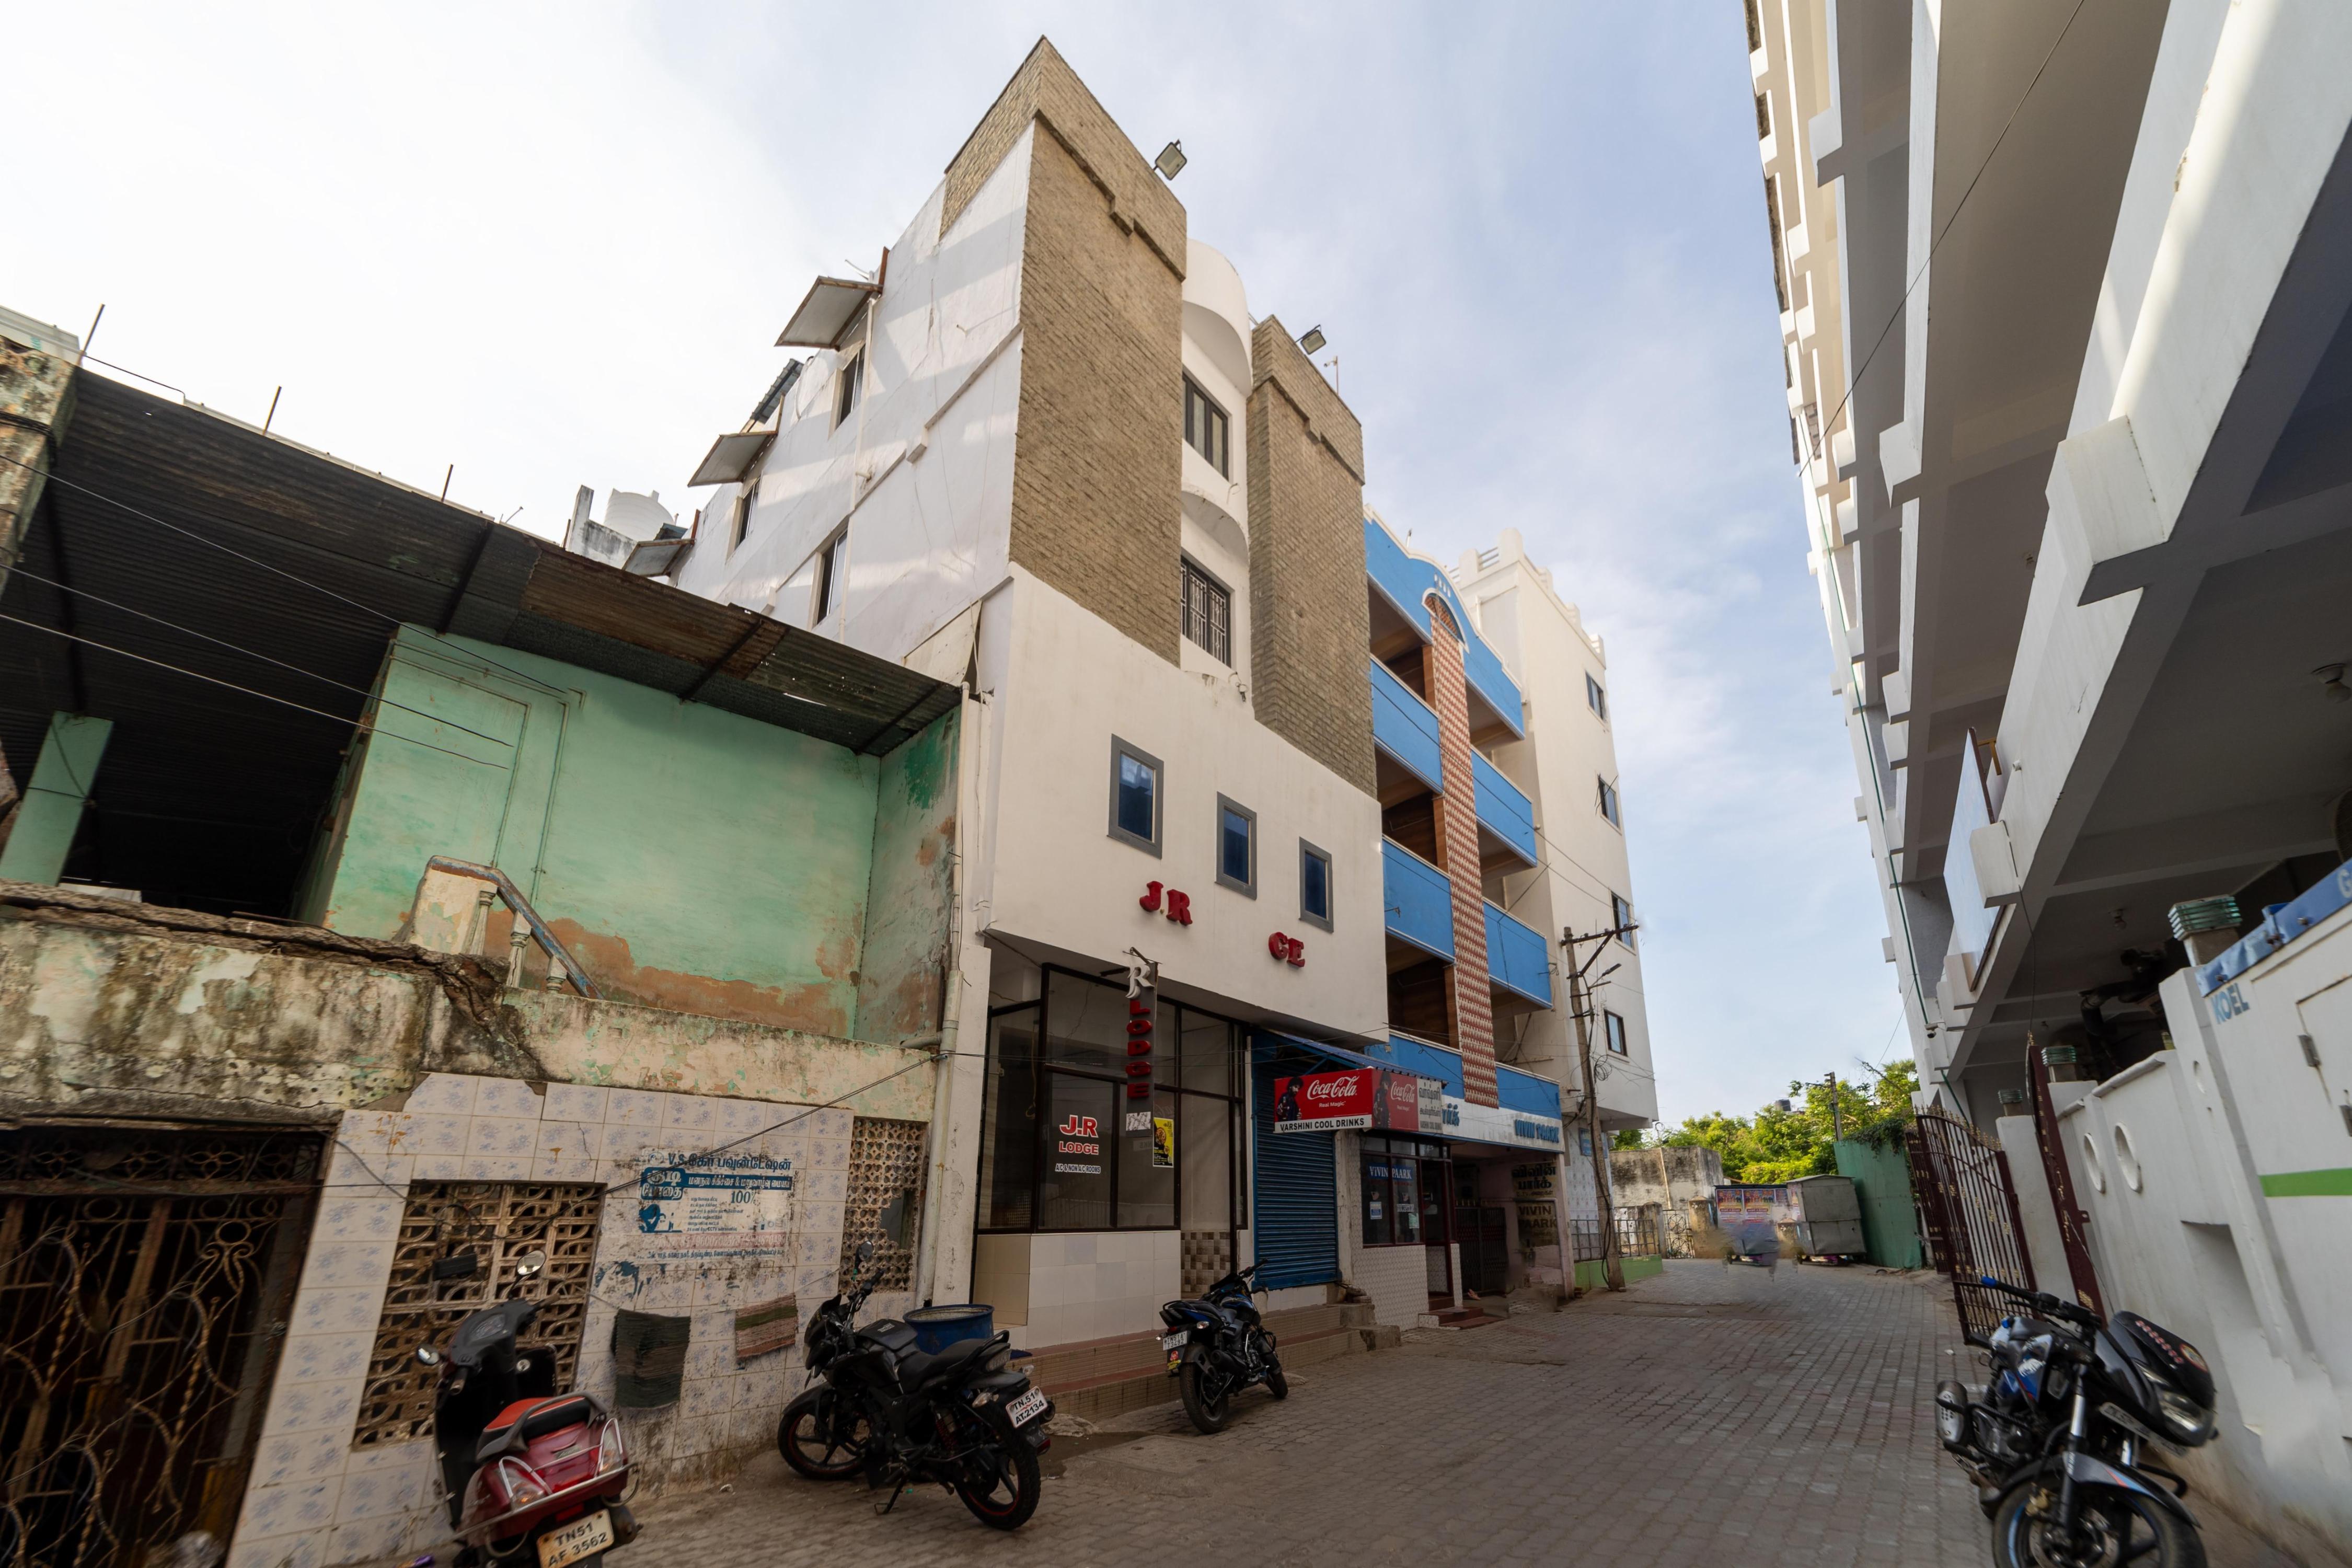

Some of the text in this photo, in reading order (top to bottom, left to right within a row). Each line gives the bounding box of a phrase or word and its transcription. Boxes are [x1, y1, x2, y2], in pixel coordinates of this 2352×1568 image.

[2211, 982, 2250, 1024] KOEL
[1125, 999, 1153, 1099] LODGE
[1307, 1075, 1361, 1100] Coca-Cola
[1059, 1114, 1099, 1138] J.R
[1280, 1118, 1365, 1131] VARSHINI COOL DRINKS
[1515, 1119, 1535, 1138] VIVIN
[1536, 1123, 1560, 1143] PAARK
[1059, 1140, 1099, 1155] LODGE
[1068, 1164, 1078, 1173] NON
[1086, 1165, 1101, 1174] ROOMS
[1392, 1168, 1412, 1180] PAARK
[735, 1177, 740, 1186] &
[1518, 1206, 1551, 1216] VIVIN
[1013, 1392, 1035, 1410] TN.51
[1016, 1400, 1044, 1424] AT.2134
[555, 1521, 593, 1546] TN51
[548, 1531, 608, 1567] AF 3562
